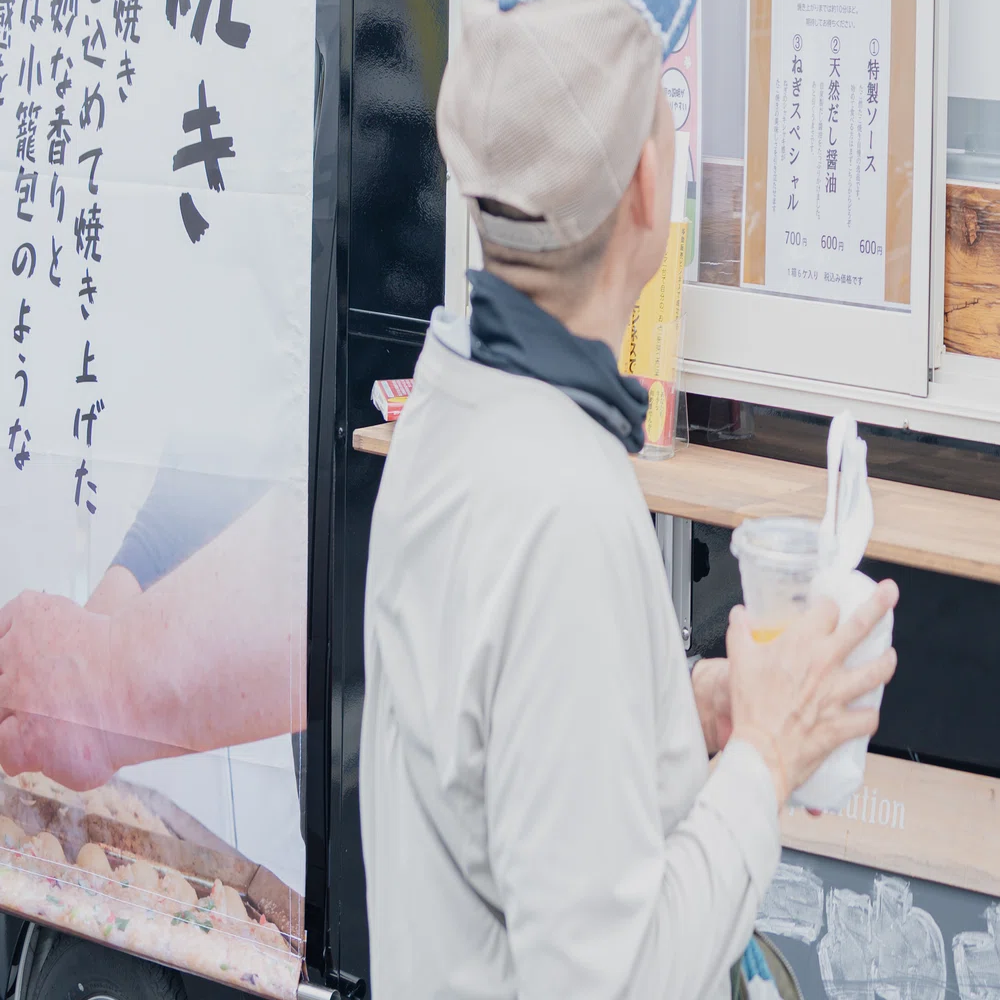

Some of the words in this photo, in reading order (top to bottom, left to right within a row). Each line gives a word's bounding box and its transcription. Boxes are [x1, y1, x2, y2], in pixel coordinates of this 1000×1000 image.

[784, 230, 808, 247] 700円
[820, 234, 844, 252] 600円
[859, 239, 883, 256] 600円
